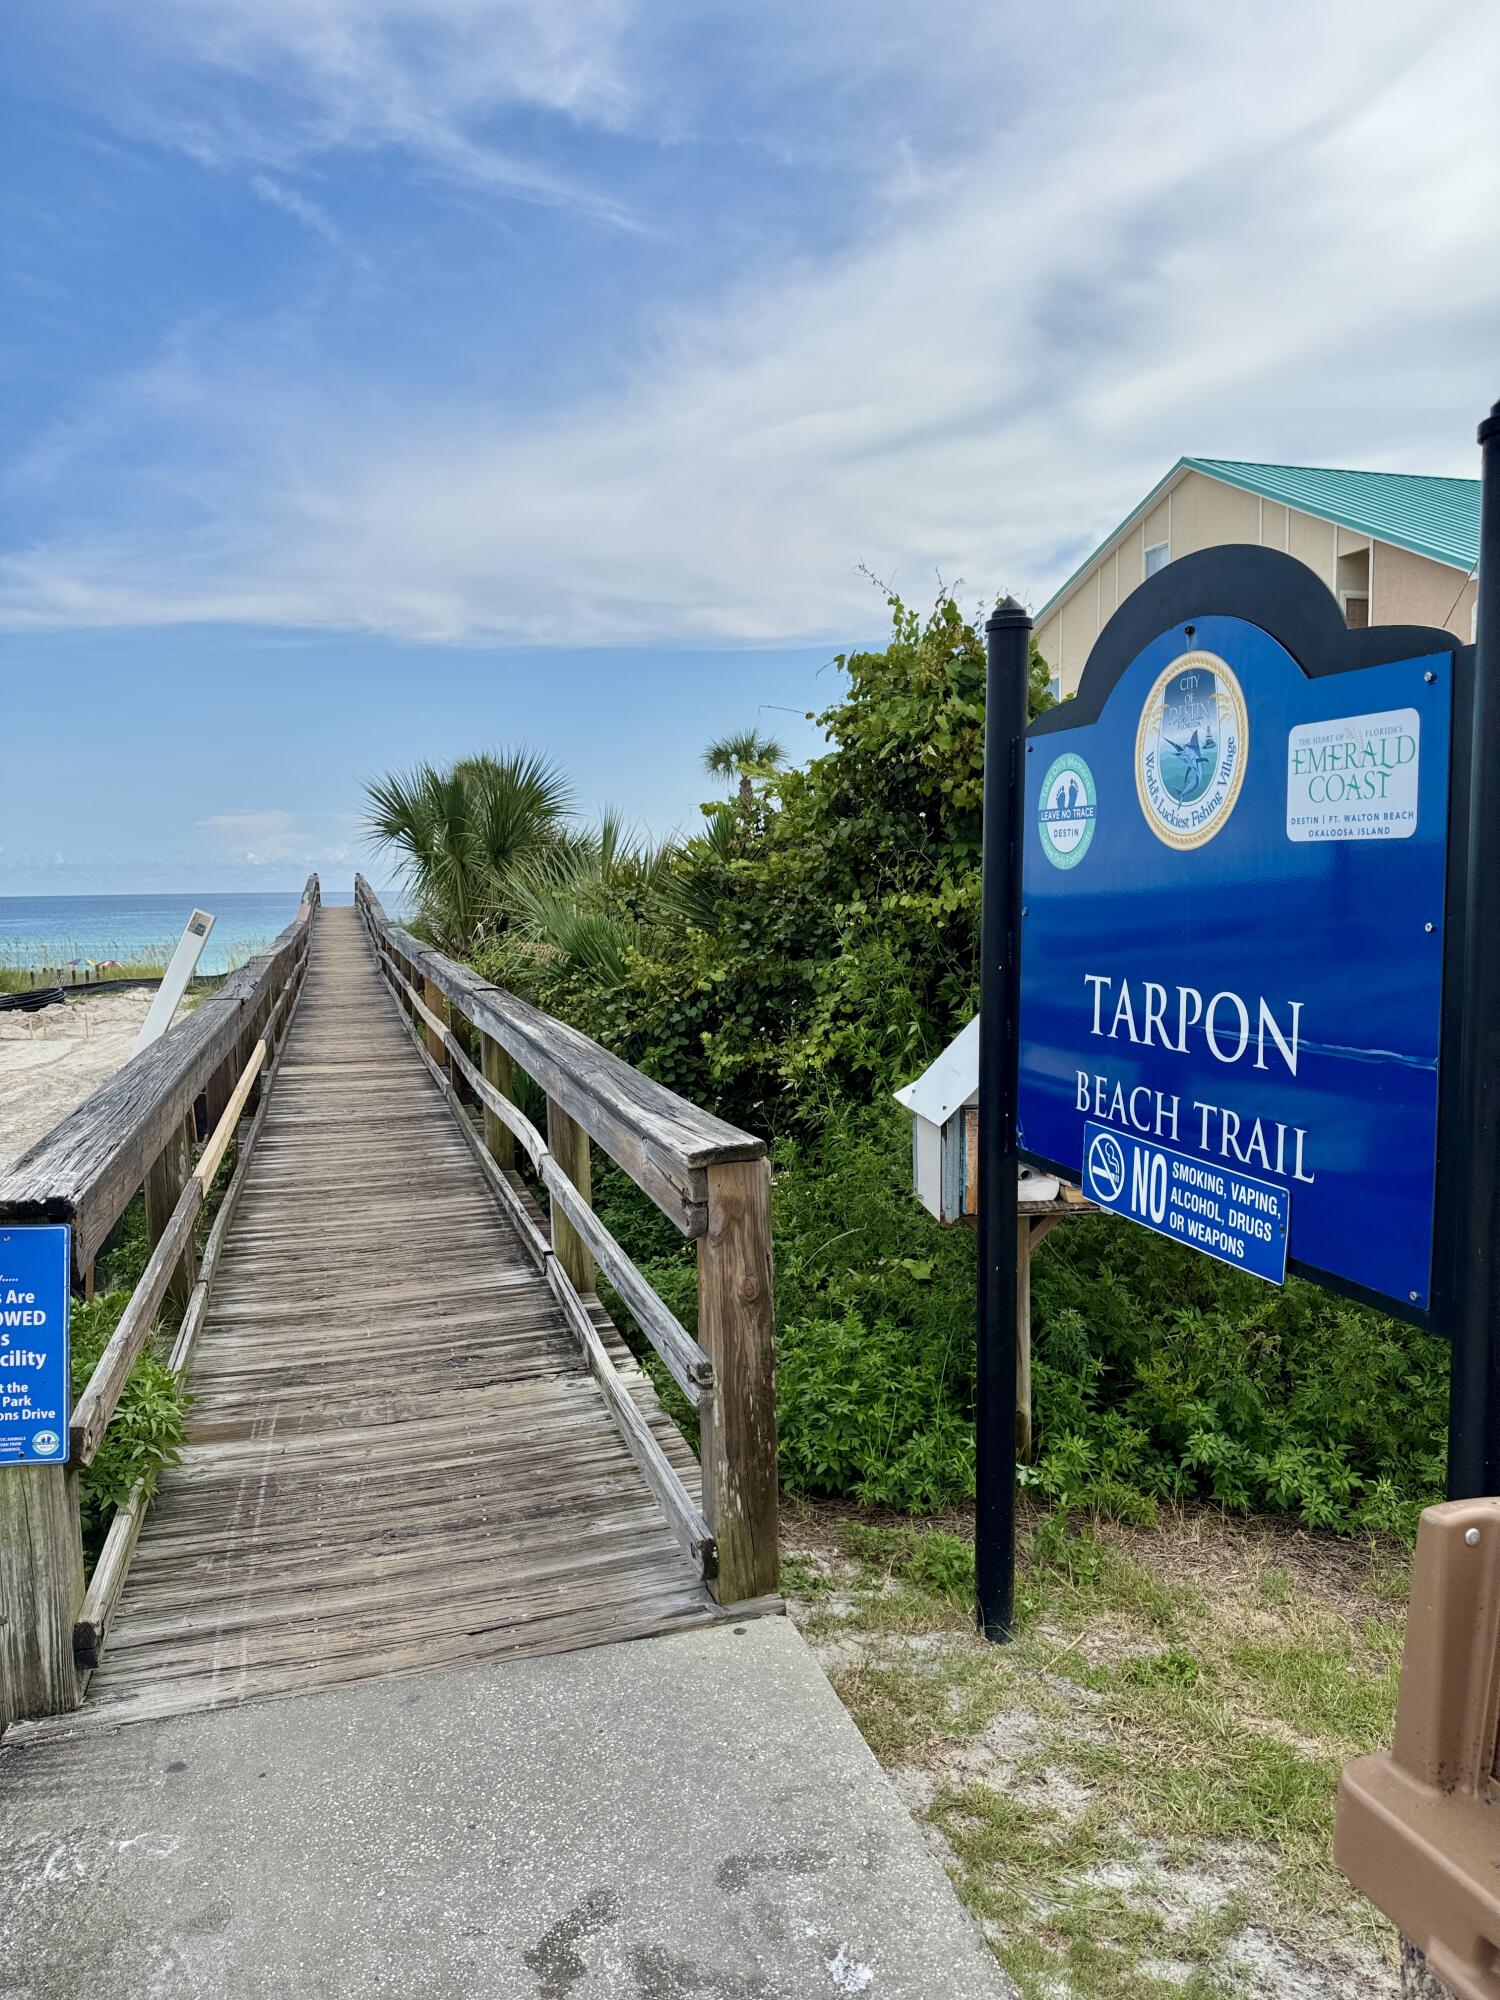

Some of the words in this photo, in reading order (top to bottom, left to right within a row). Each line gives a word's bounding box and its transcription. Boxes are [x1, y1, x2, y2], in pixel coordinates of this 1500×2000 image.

[1180, 675, 1200, 691] CITY
[1184, 693, 1194, 704] OF
[1169, 700, 1210, 725] DESTIN
[1299, 738, 1310, 746] THE
[1313, 735, 1333, 744] HEART
[1335, 733, 1344, 741] OF
[1365, 725, 1402, 737] FLORIDA'S
[1291, 735, 1416, 775] EMERALD
[1145, 752, 1160, 804] World's
[1157, 799, 1190, 828] Luckiest
[1191, 791, 1223, 827] Fishing
[1217, 736, 1236, 785] Village
[1308, 770, 1392, 803] COAST
[1041, 810, 1060, 821] LEAVE
[1061, 809, 1072, 819] NO
[1072, 807, 1094, 818] TRACE
[1291, 816, 1319, 825] DESTIN
[1328, 815, 1340, 824] FT.
[1343, 812, 1380, 822] WALTON
[1383, 811, 1414, 820] BEACH
[1053, 828, 1079, 838] DESTIN
[1308, 828, 1353, 838] OKALOOSA
[1358, 826, 1390, 836] ISLAND
[1084, 973, 1304, 1077] TARPON
[1075, 1070, 1181, 1142] BEACH
[1193, 1101, 1315, 1184] TRAIL
[1131, 1146, 1168, 1224] NO
[1172, 1161, 1227, 1200] SMOKING,
[1230, 1182, 1281, 1220] VAPING,
[1170, 1186, 1225, 1226] ALCOHOL,
[1228, 1208, 1272, 1242] DRUGS
[1169, 1211, 1185, 1233] OR
[1187, 1216, 1245, 1259] WEAPONS
[5, 1289, 35, 1304] Are
[6, 1381, 29, 1393] the
[2, 1394, 32, 1407] Park
[22, 1408, 56, 1420] Drive
